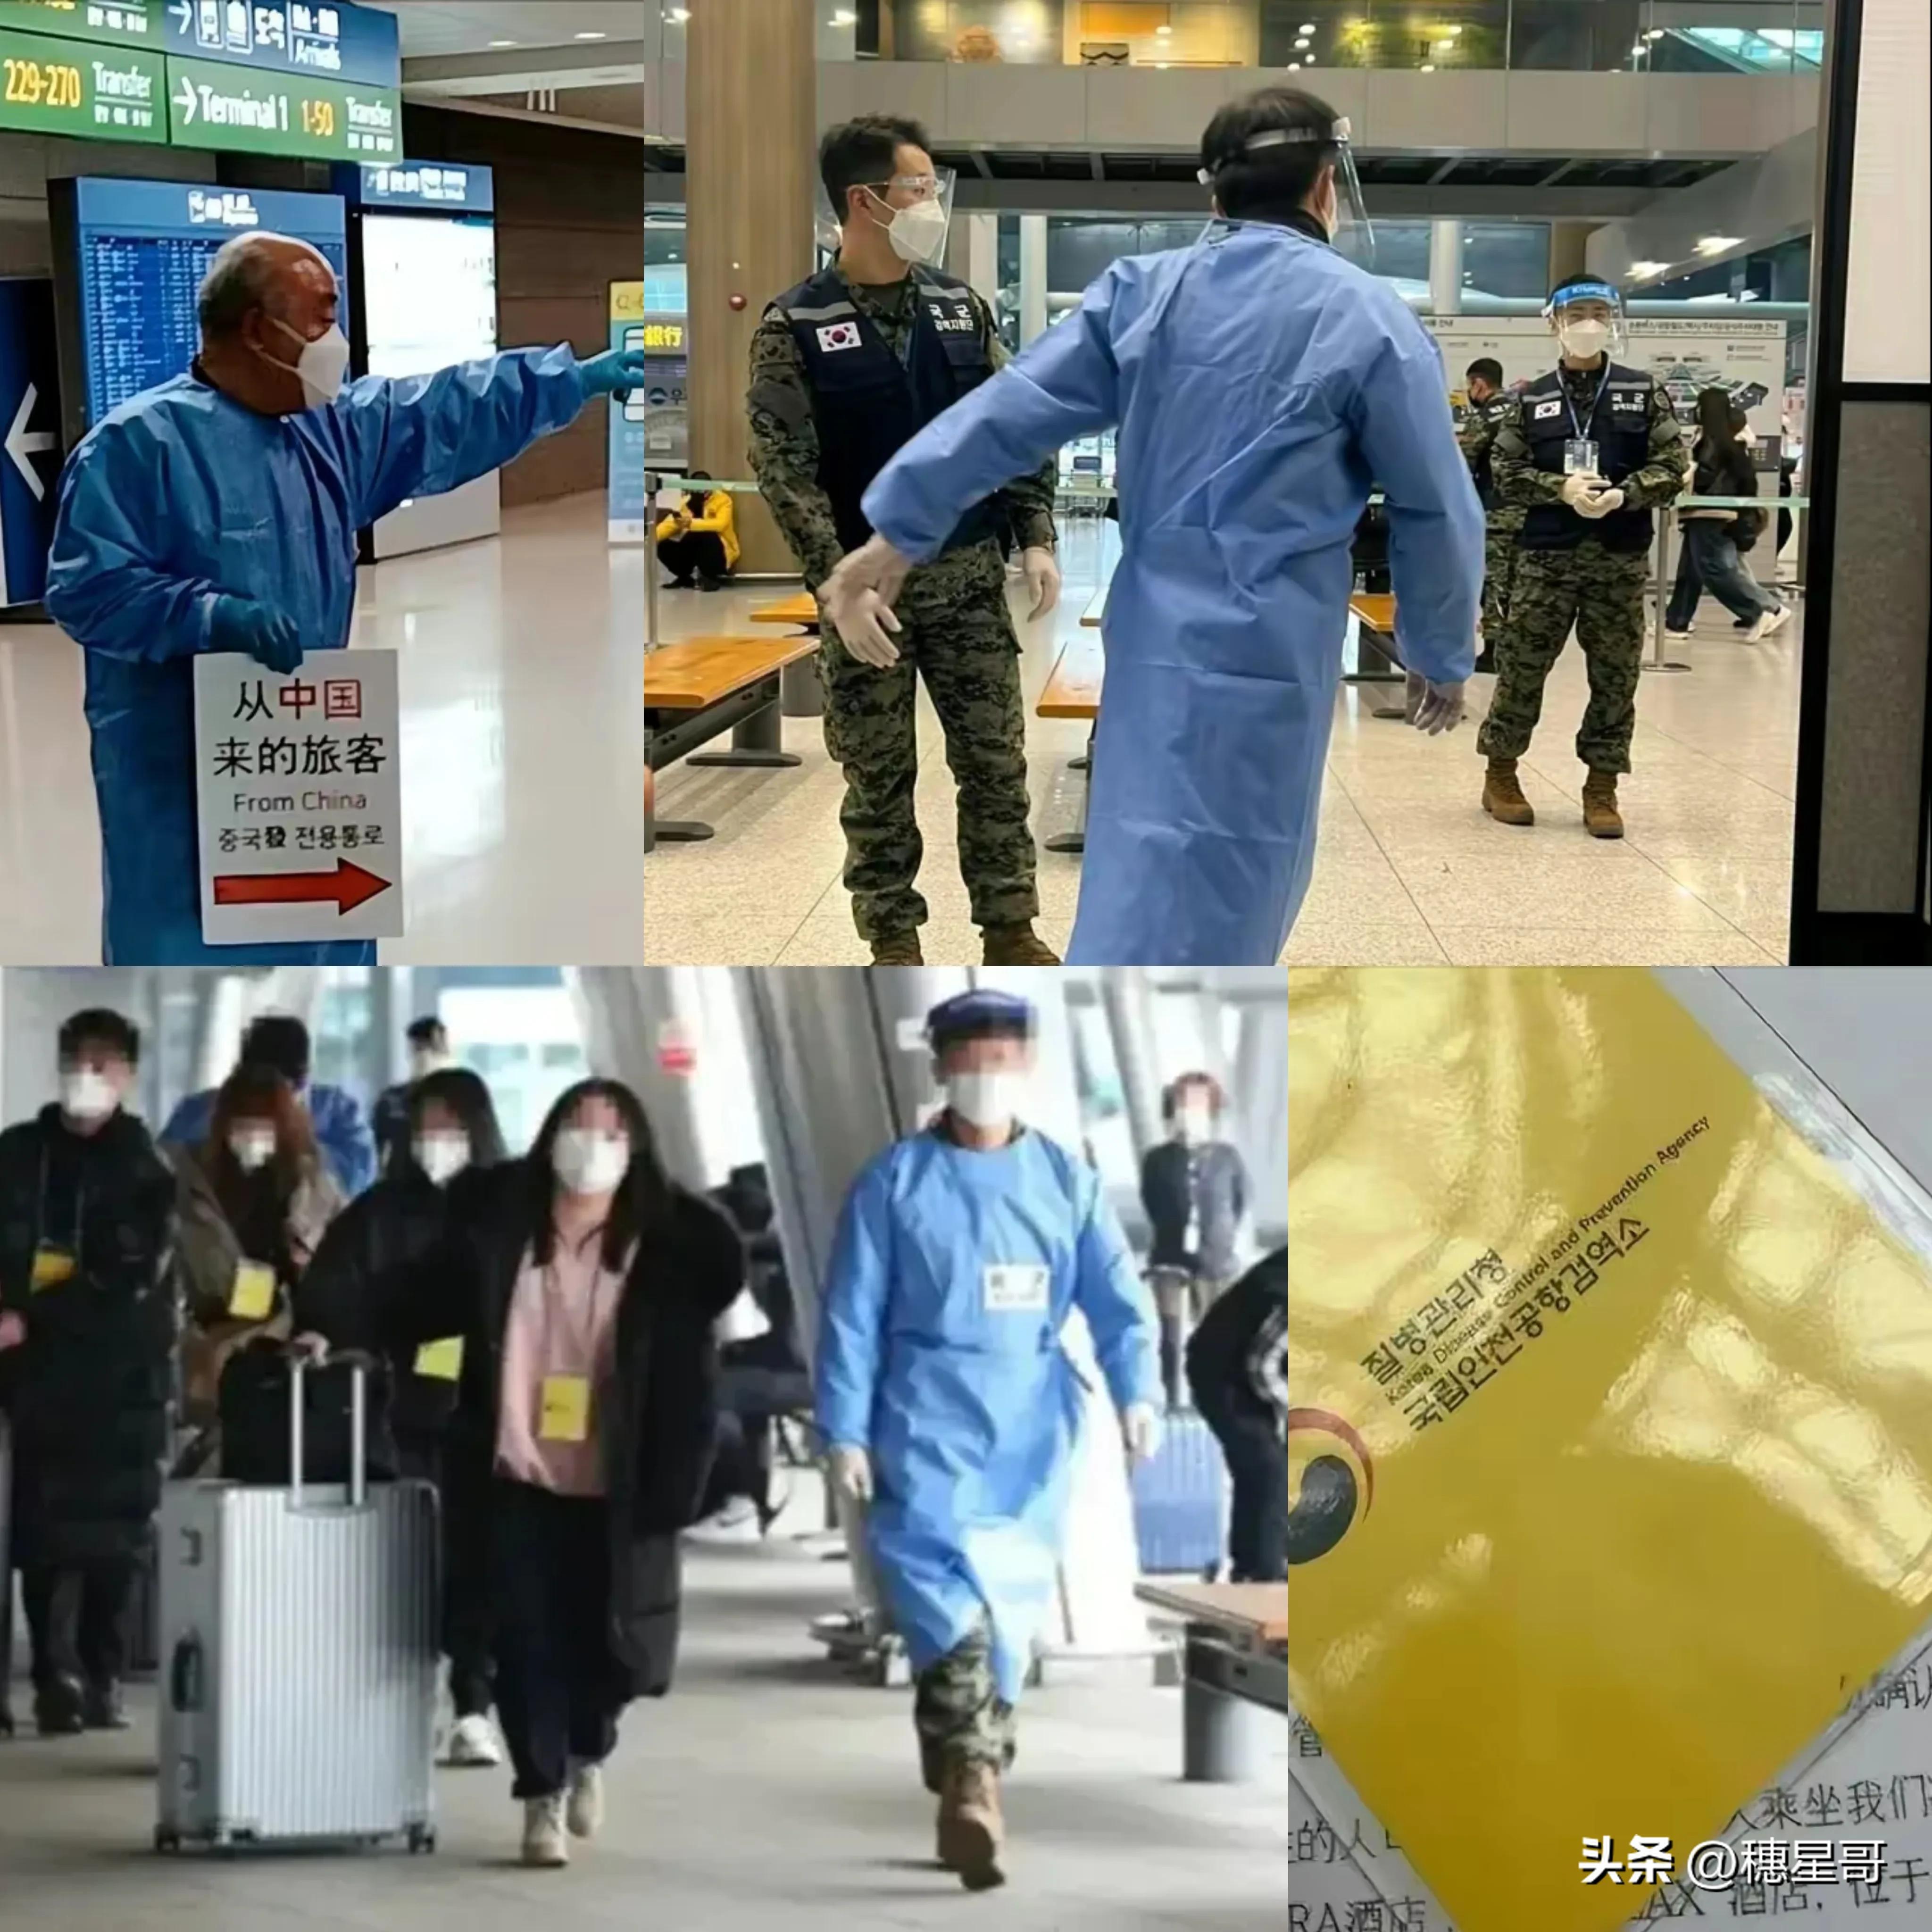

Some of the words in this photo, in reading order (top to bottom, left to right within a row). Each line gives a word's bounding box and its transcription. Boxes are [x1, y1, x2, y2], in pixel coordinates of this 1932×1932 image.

[4, 59, 81, 107] 229-270
[92, 61, 151, 98] Transfer
[198, 84, 277, 130] Terminal
[302, 100, 334, 136] 1-50
[234, 678, 362, 722] 从中国
[213, 733, 387, 778] 来的旅客
[233, 793, 294, 813] From
[301, 790, 367, 811] China
[295, 824, 385, 850] 전용통로
[1493, 1256, 1550, 1308] Control
[1550, 1229, 1581, 1261] and
[1578, 1163, 1657, 1233] Prevention
[1656, 1116, 1711, 1165] Agency
[1360, 1248, 1506, 1386] 질병관리청
[1403, 1217, 1650, 1432] 국립인천공항검역소
[1722, 1774, 1932, 1835] 人乘坐我们
